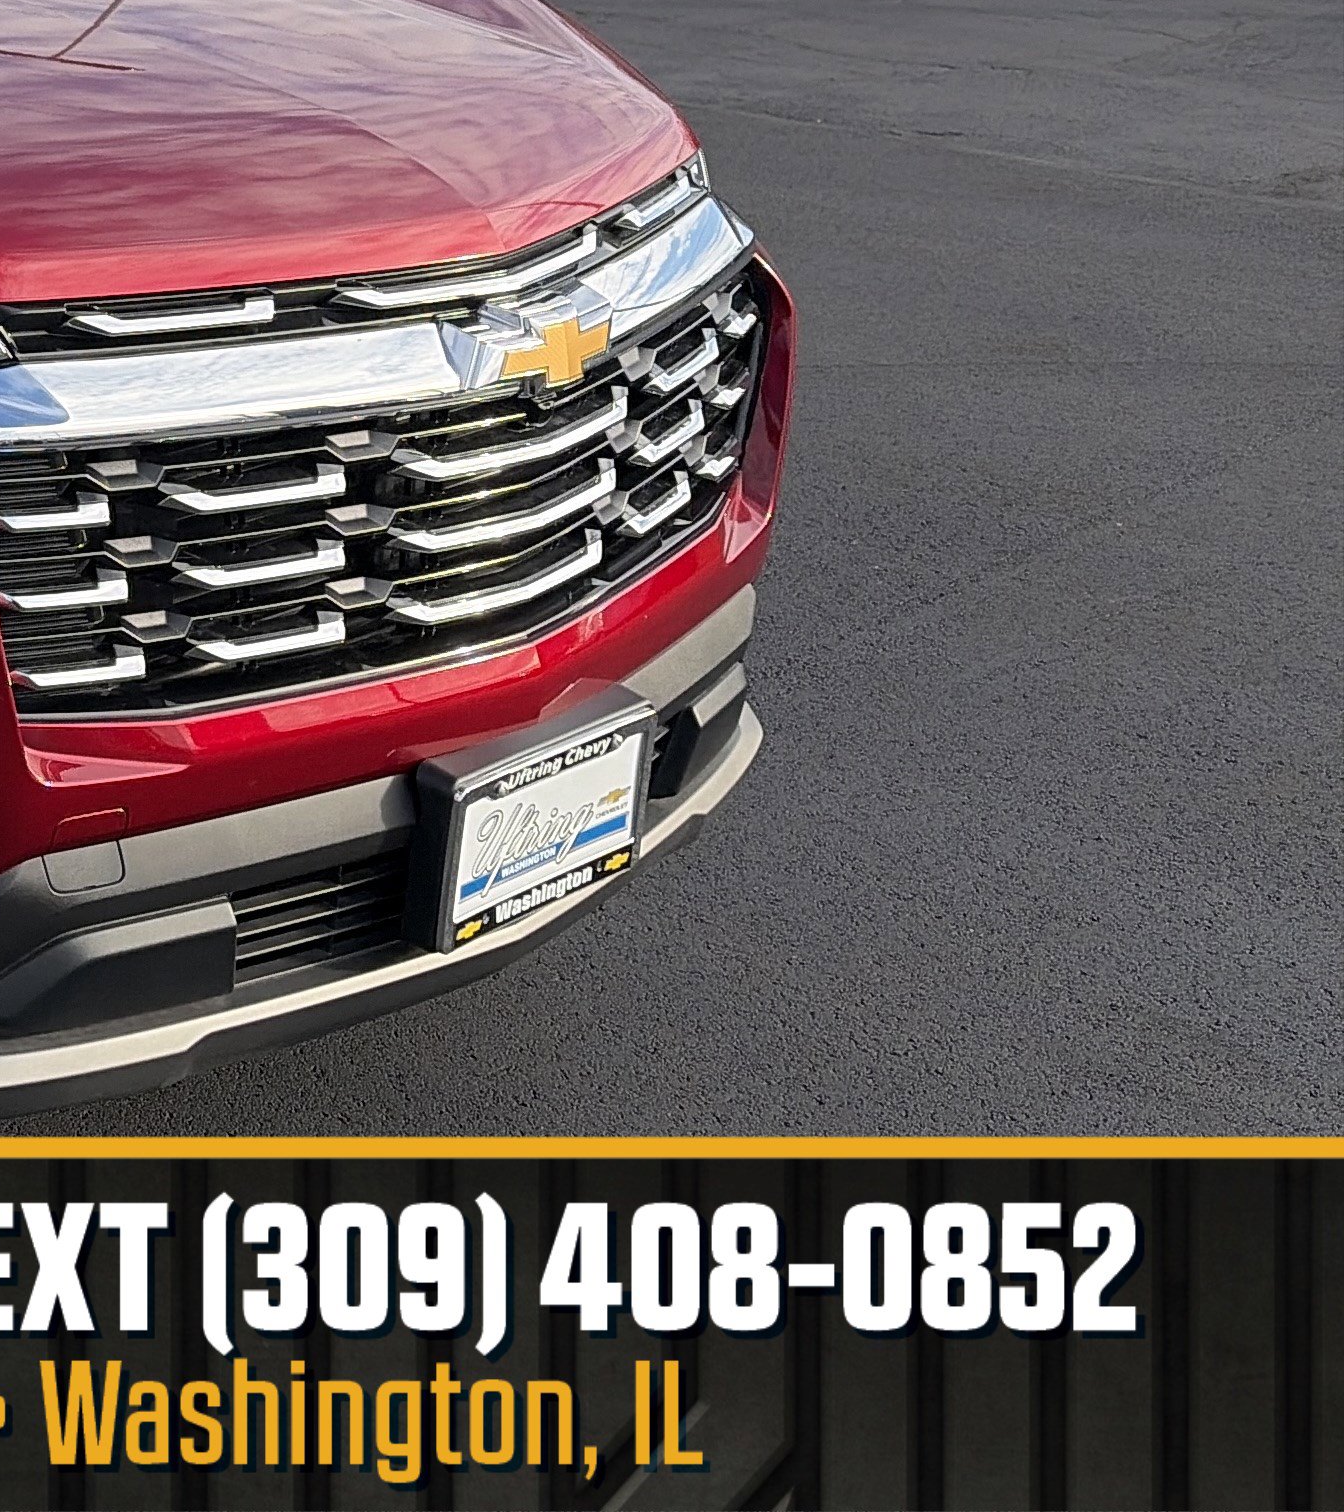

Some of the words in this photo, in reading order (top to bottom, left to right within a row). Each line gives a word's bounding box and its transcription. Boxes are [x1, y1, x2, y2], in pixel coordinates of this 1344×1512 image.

[507, 756, 563, 790] Uftring
[564, 737, 611, 766] Chevy
[472, 803, 594, 897] Uftring
[501, 846, 557, 878] WASHINGTON
[495, 865, 593, 924] Washington
